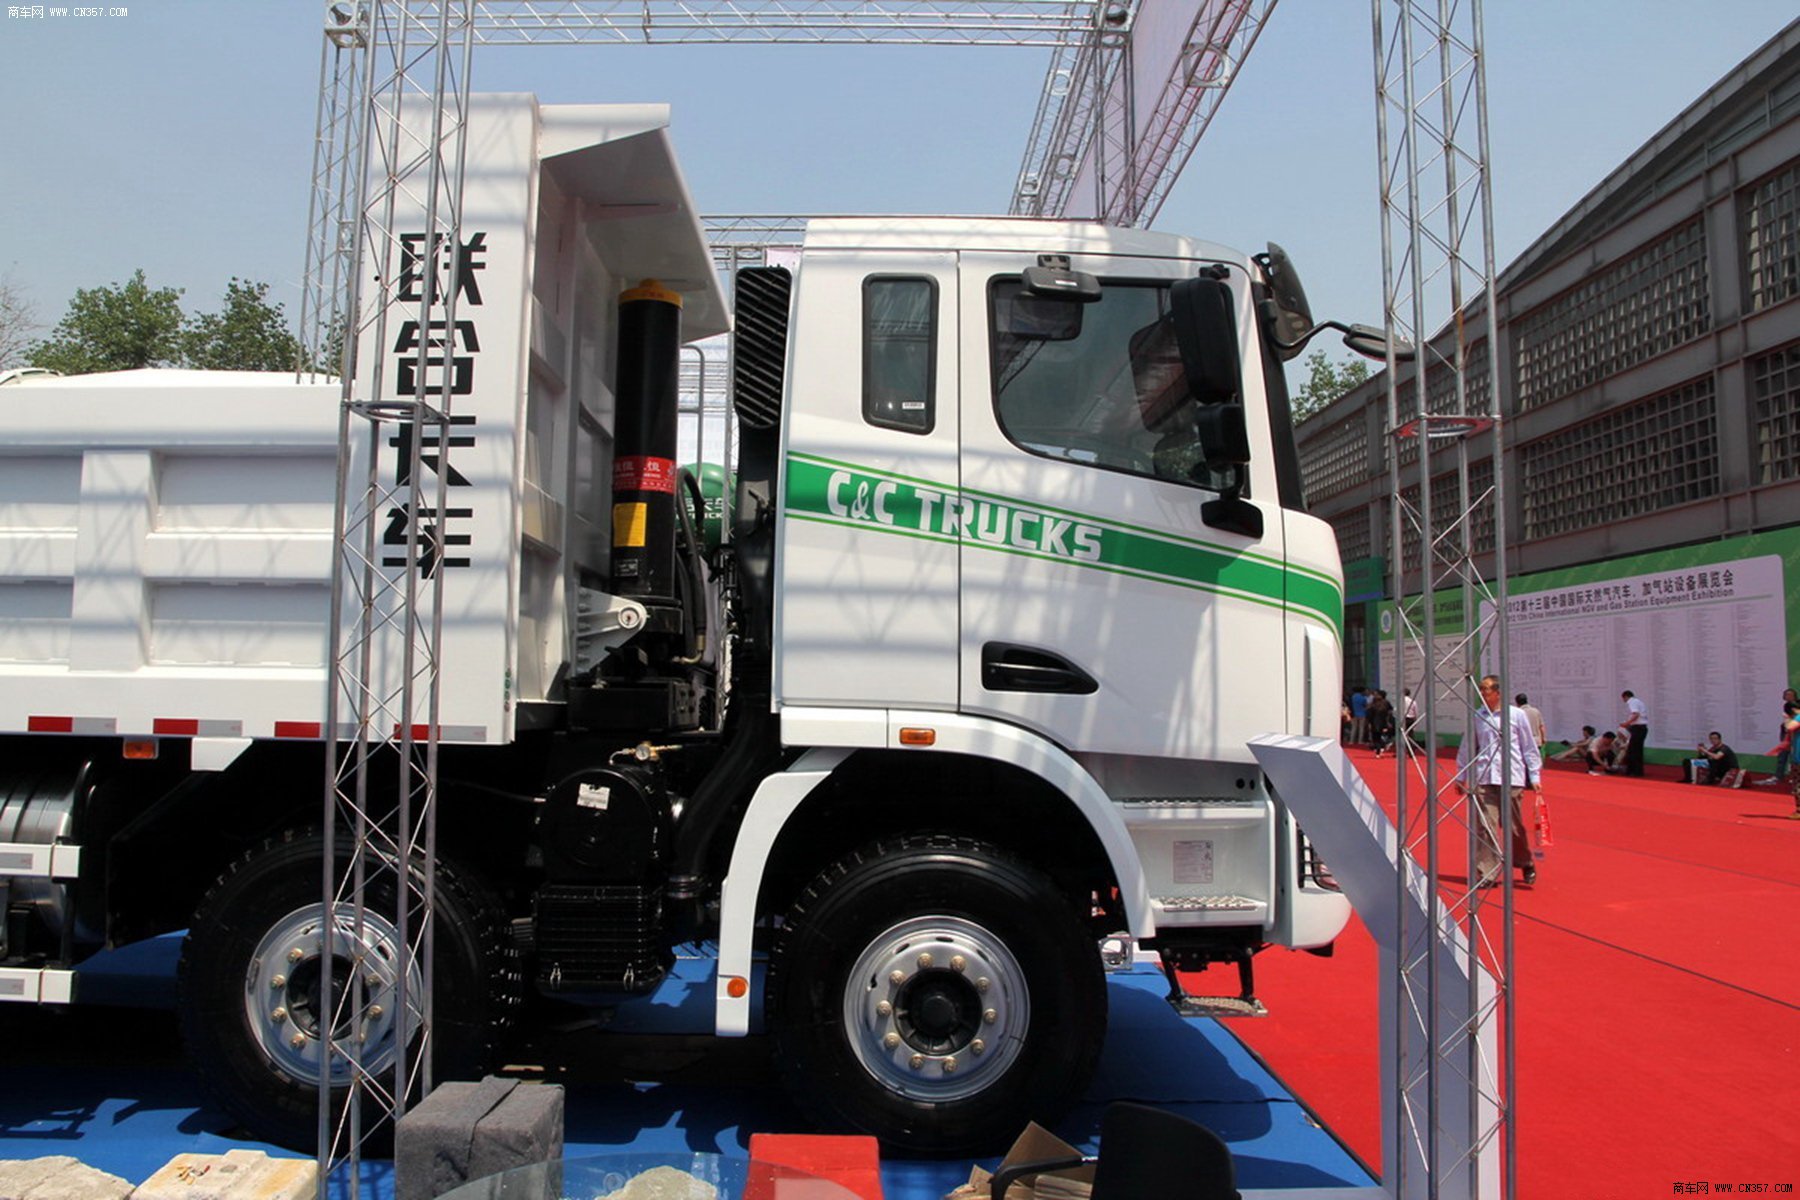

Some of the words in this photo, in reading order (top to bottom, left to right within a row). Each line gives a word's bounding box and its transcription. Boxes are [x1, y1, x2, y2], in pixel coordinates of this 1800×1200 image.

[382, 231, 487, 580] 联合卡车
[827, 470, 897, 525] C&C
[914, 488, 1103, 562] TRUCKS
[1508, 568, 1734, 613] 012第十三届中国国际天然气汽车、加气站设备展览会
[1528, 611, 1544, 619] China
[1545, 605, 1580, 617] International
[1581, 604, 1595, 613] NGV
[1596, 602, 1608, 611] and
[1609, 601, 1622, 610] Gas
[1624, 599, 1649, 609] Station
[1650, 593, 1690, 606] Equipment
[1691, 588, 1734, 601] Exhibition
